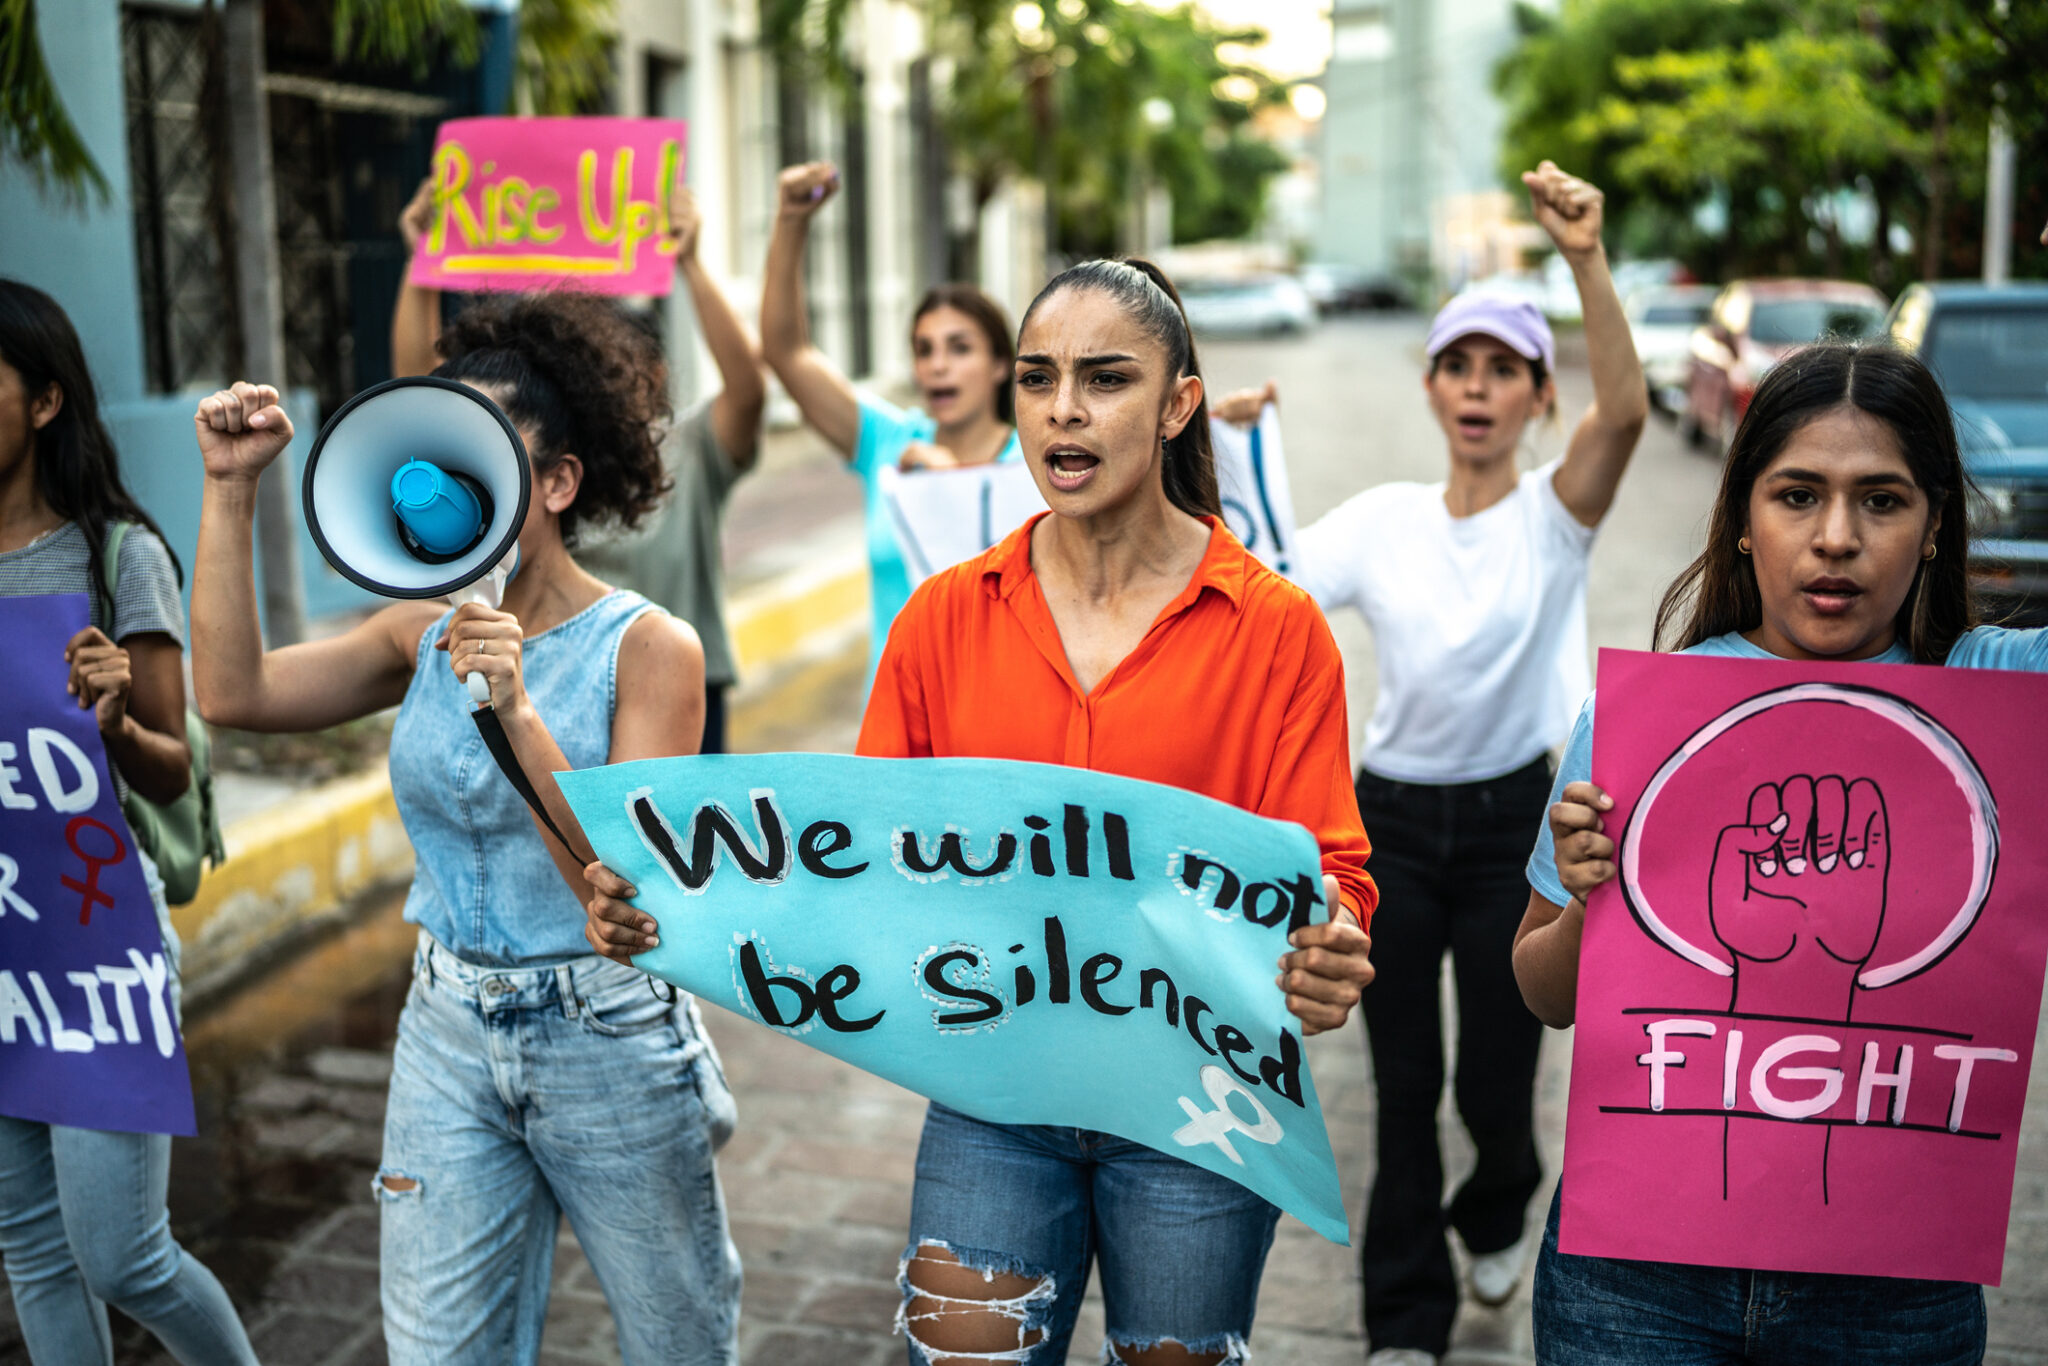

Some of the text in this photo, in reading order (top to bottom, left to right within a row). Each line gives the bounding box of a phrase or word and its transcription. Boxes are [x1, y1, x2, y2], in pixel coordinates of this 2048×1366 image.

[426, 138, 682, 274] Rise Up!
[0, 728, 99, 814] ED
[625, 787, 1326, 942] We will not
[0, 947, 176, 1059] ALITY
[728, 915, 1306, 1109] be Silenced
[1637, 1018, 2018, 1133] FIGHT
